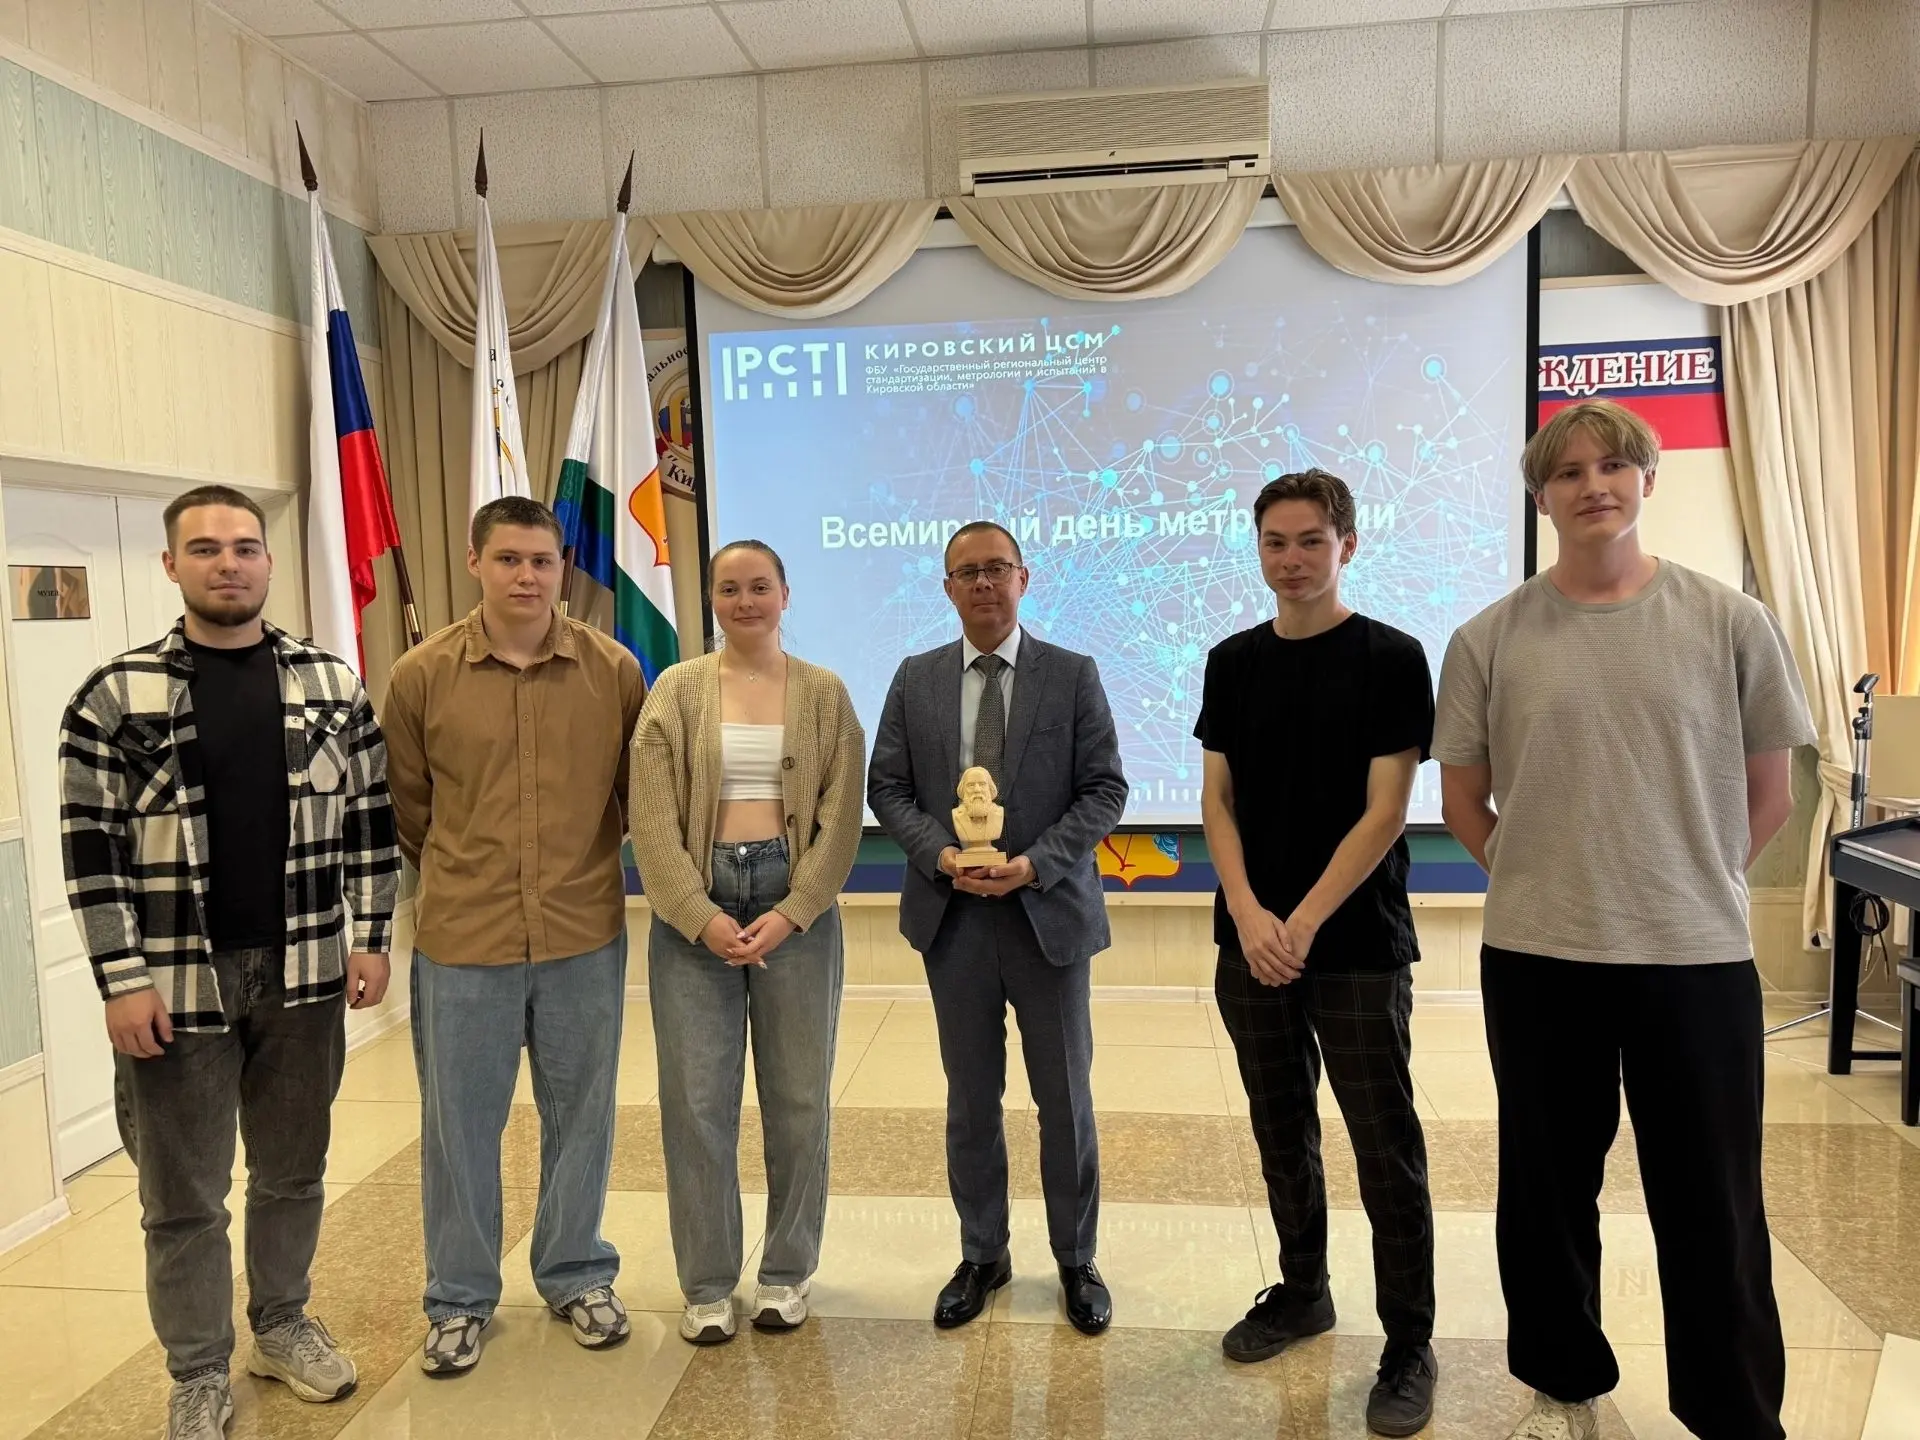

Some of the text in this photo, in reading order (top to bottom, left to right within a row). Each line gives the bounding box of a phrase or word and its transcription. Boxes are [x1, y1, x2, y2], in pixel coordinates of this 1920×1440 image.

[865, 332, 1103, 360] КИРОВСКИЙ ЦСМ
[736, 342, 829, 378] РСТ
[865, 355, 1107, 375] ФБУ «Государственный региональный центр
[865, 374, 953, 386] стандартизации,
[957, 371, 1021, 382] метрологии
[1037, 365, 1096, 377] испытаний
[1100, 365, 1107, 374] в
[866, 381, 975, 396] Кировской области»
[821, 508, 1040, 552] Всемирй
[1051, 511, 1145, 548] день
